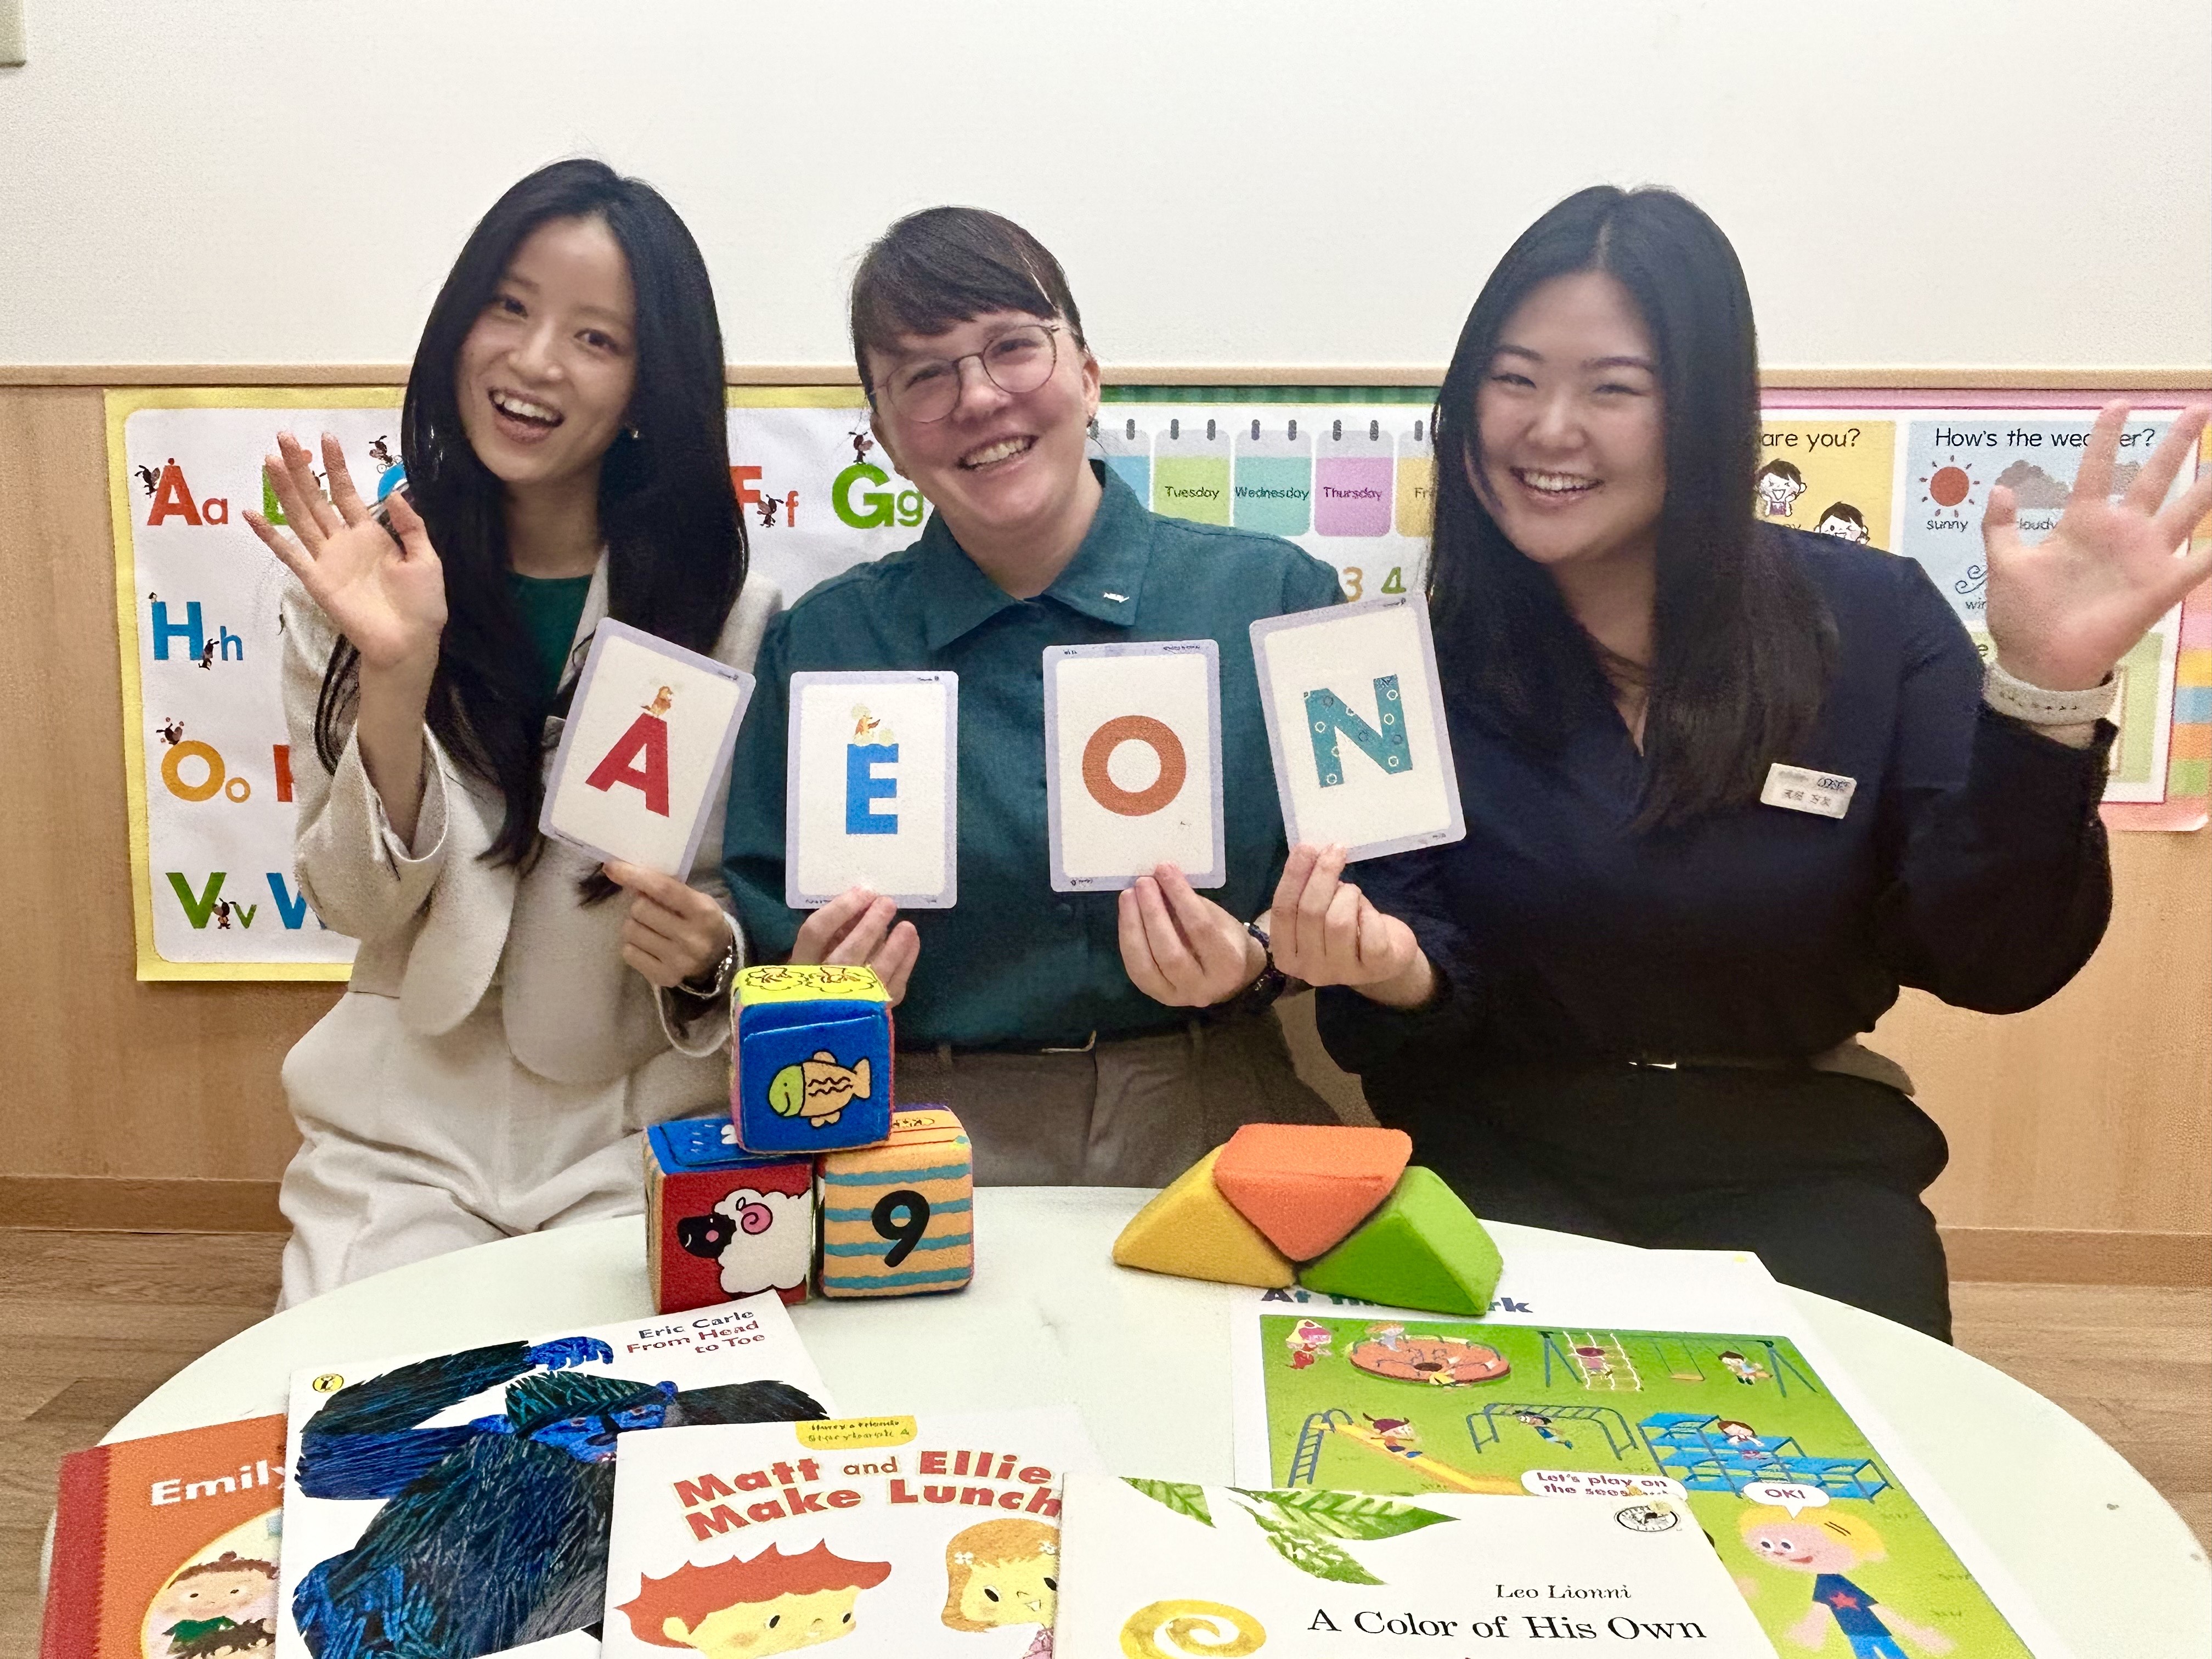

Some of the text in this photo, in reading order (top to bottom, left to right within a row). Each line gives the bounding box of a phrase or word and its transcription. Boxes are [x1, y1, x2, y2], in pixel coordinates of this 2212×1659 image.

[1762, 428, 1861, 453] are you?
[1936, 428, 2155, 447] How's the weer?
[147, 465, 228, 526] Aa
[832, 464, 924, 529] Gg
[1165, 486, 1220, 500] Tuesday
[1235, 486, 1310, 501] Wednesday
[1324, 486, 1383, 501] Thursday
[1926, 520, 1968, 532] sunny
[1343, 566, 1363, 602] 3
[1380, 566, 1407, 594] 4
[151, 601, 243, 661] Hh
[1304, 674, 1413, 788] N
[161, 740, 251, 803] Oo
[585, 712, 669, 818] A
[1082, 715, 1186, 816] O
[845, 743, 899, 834] E
[166, 871, 257, 929] Vv
[871, 1189, 930, 1268] 9
[627, 1320, 759, 1353] From Head
[639, 1311, 754, 1339] Eric Carle
[695, 1334, 765, 1353] to Toe
[673, 1451, 1052, 1508] Matt and Ellie
[1537, 1472, 1581, 1483] Let's
[1588, 1475, 1633, 1487] play
[1544, 1483, 1577, 1493] the
[1765, 1488, 1806, 1499] OK!
[686, 1479, 1062, 1542] Make Lunch
[1496, 1584, 1632, 1600] Leo Lionni
[1308, 1608, 1707, 1640] A Color of His Own
